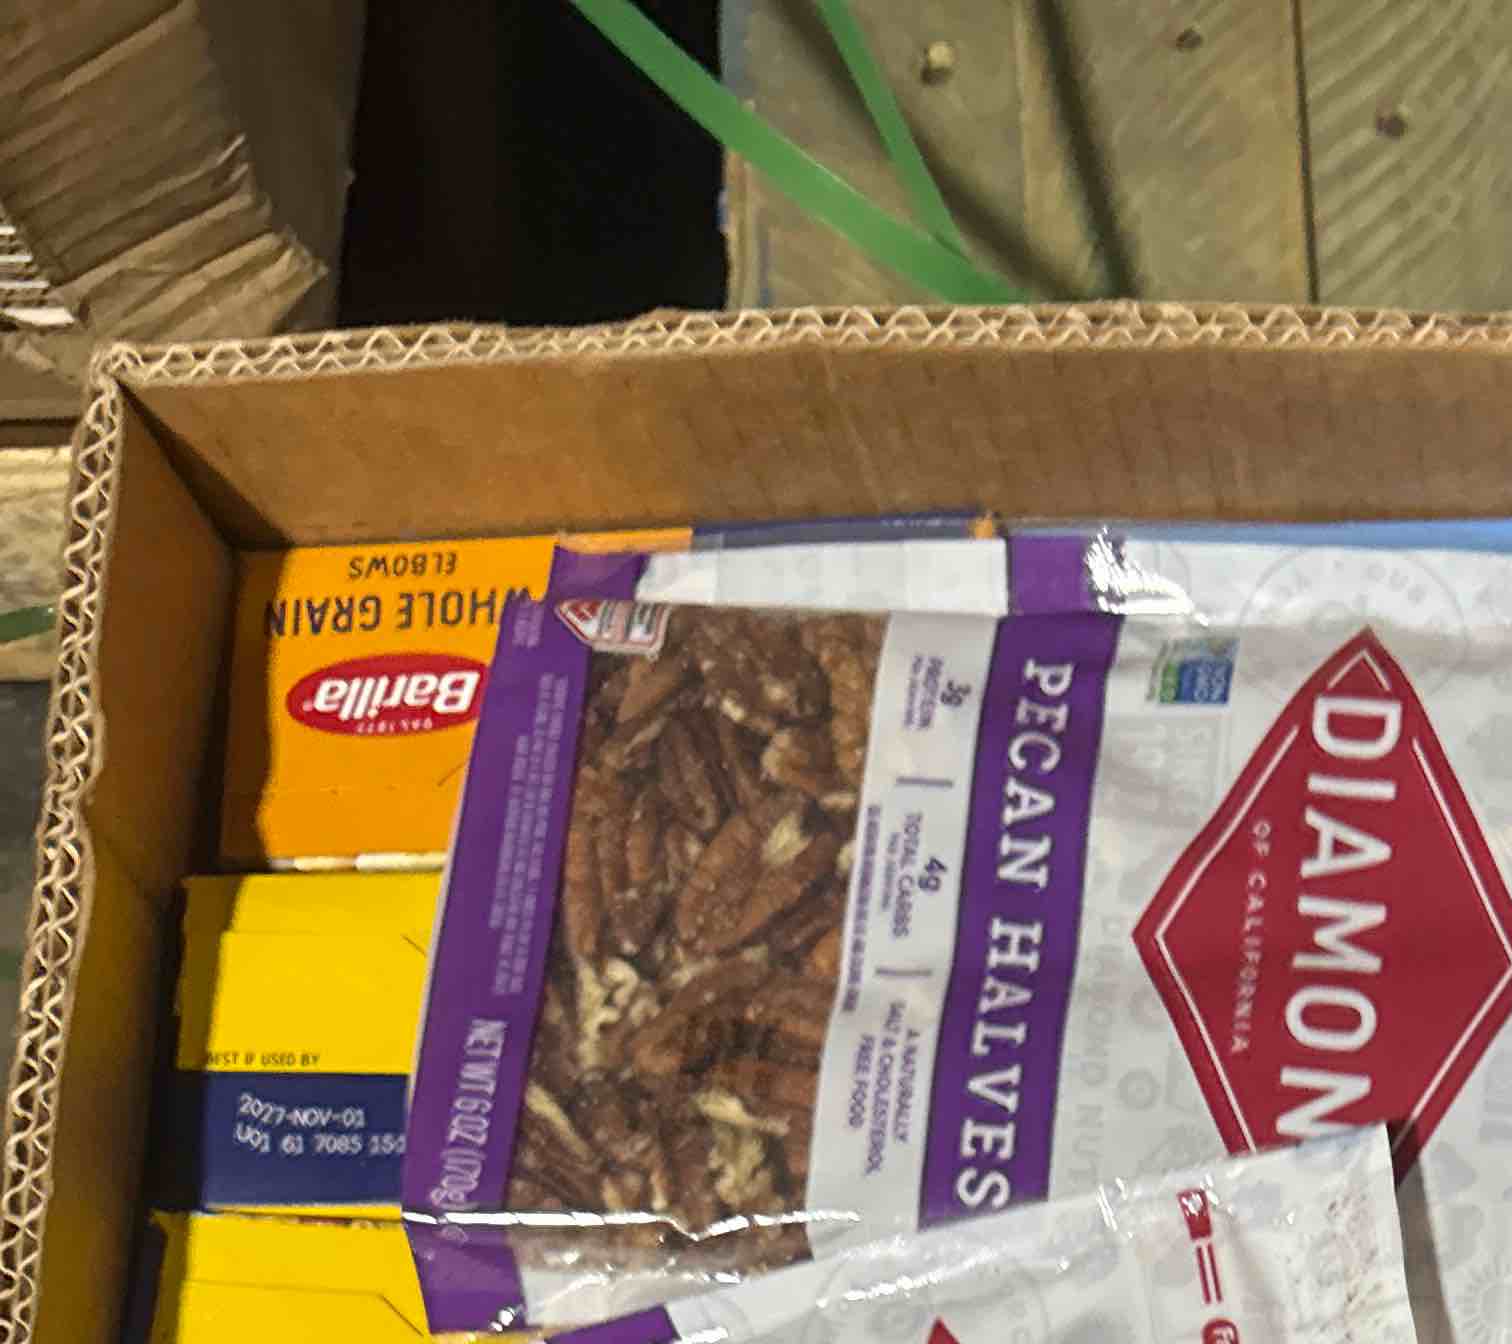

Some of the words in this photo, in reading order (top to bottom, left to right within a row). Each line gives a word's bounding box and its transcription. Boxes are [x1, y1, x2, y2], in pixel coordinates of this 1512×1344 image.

[349, 552, 457, 579] ELBOWS
[267, 594, 382, 638] GRAIN
[313, 671, 481, 721] Barilla
[997, 658, 1074, 889] PECAN
[1252, 819, 1272, 857] OF
[919, 857, 948, 892] 4g
[1275, 696, 1403, 1147] DIAMON
[1230, 872, 1267, 1055] CALIFORNIA
[956, 917, 1043, 1209] HALVES
